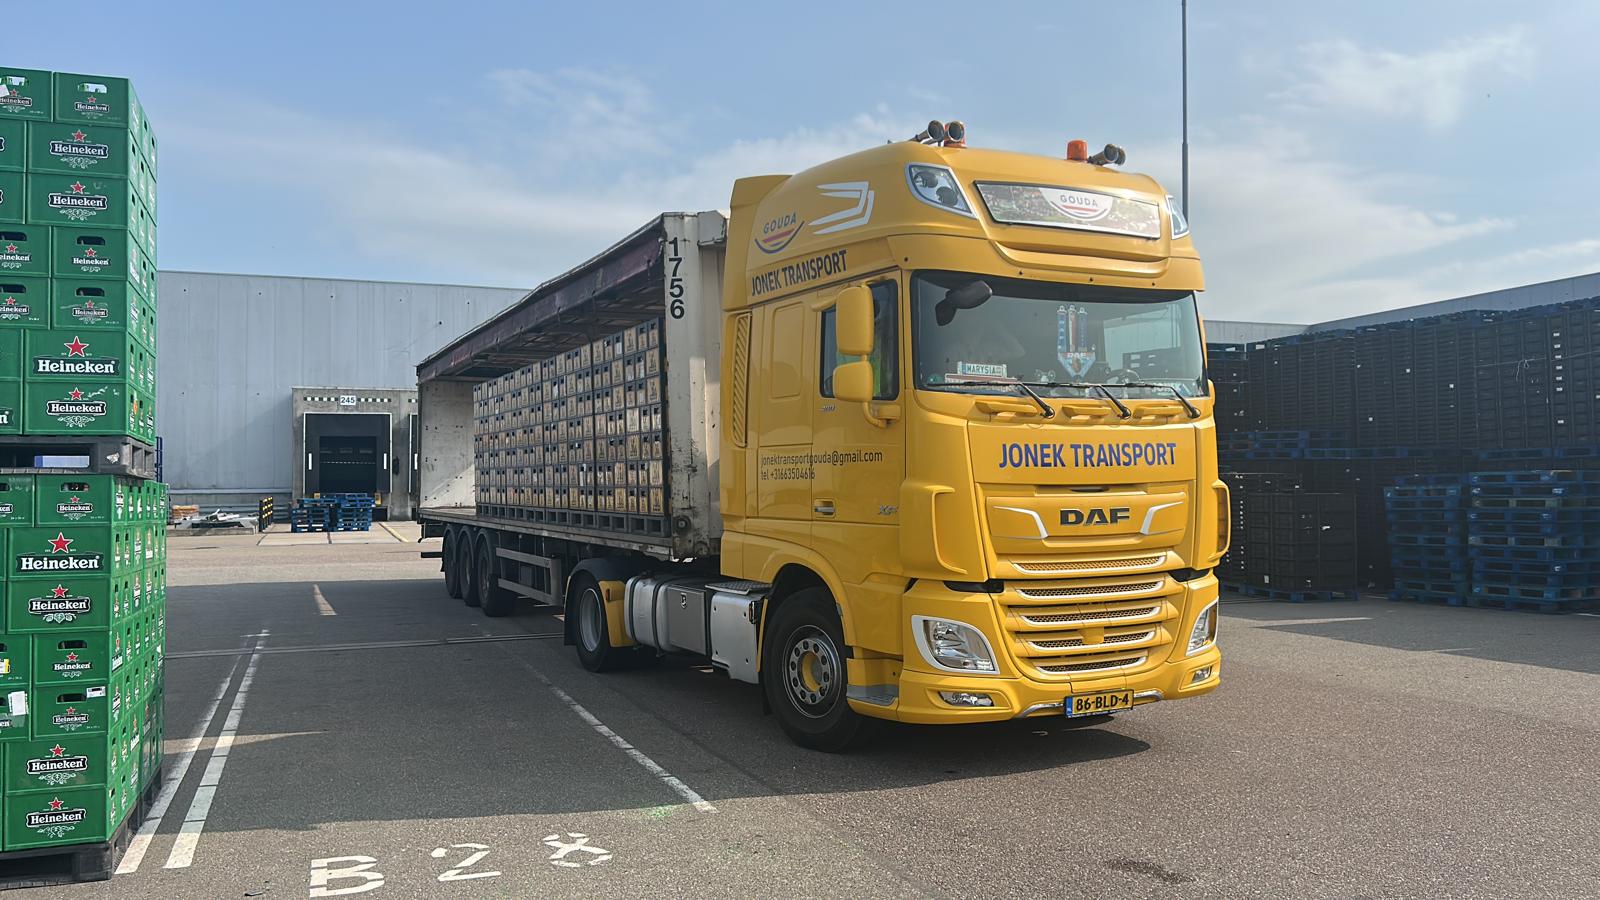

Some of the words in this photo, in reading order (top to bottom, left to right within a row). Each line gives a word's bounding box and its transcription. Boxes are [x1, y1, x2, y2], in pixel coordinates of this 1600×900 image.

[77, 103, 107, 111] Heineken
[54, 144, 104, 156] Heineken
[53, 195, 104, 207] Heineken
[1060, 194, 1098, 207] GOUDA
[763, 212, 797, 234] GOUDA
[0, 254, 30, 262] eineken
[73, 257, 109, 266] Heineken
[668, 236, 685, 320] 1756
[751, 270, 782, 296] JONEK
[782, 249, 847, 287] TRANSPORT
[37, 359, 115, 374] Heineken
[967, 364, 996, 374] MARYSIA
[341, 396, 355, 404] 245
[51, 403, 103, 413] Heineken
[760, 450, 883, 468] jonektransportgouda@gmail.com
[999, 443, 1066, 469] JONEK
[1070, 442, 1177, 468] TRANSPORT
[59, 504, 91, 512] Heineken
[1060, 508, 1130, 526] DAF
[21, 555, 100, 570] Heineken
[32, 599, 87, 611] Heineken
[54, 662, 91, 671] Heineken
[1076, 693, 1129, 711] 86-BLD-4
[55, 715, 87, 723] Heineken
[31, 758, 84, 771] Heineken
[30, 811, 82, 824] Heineken
